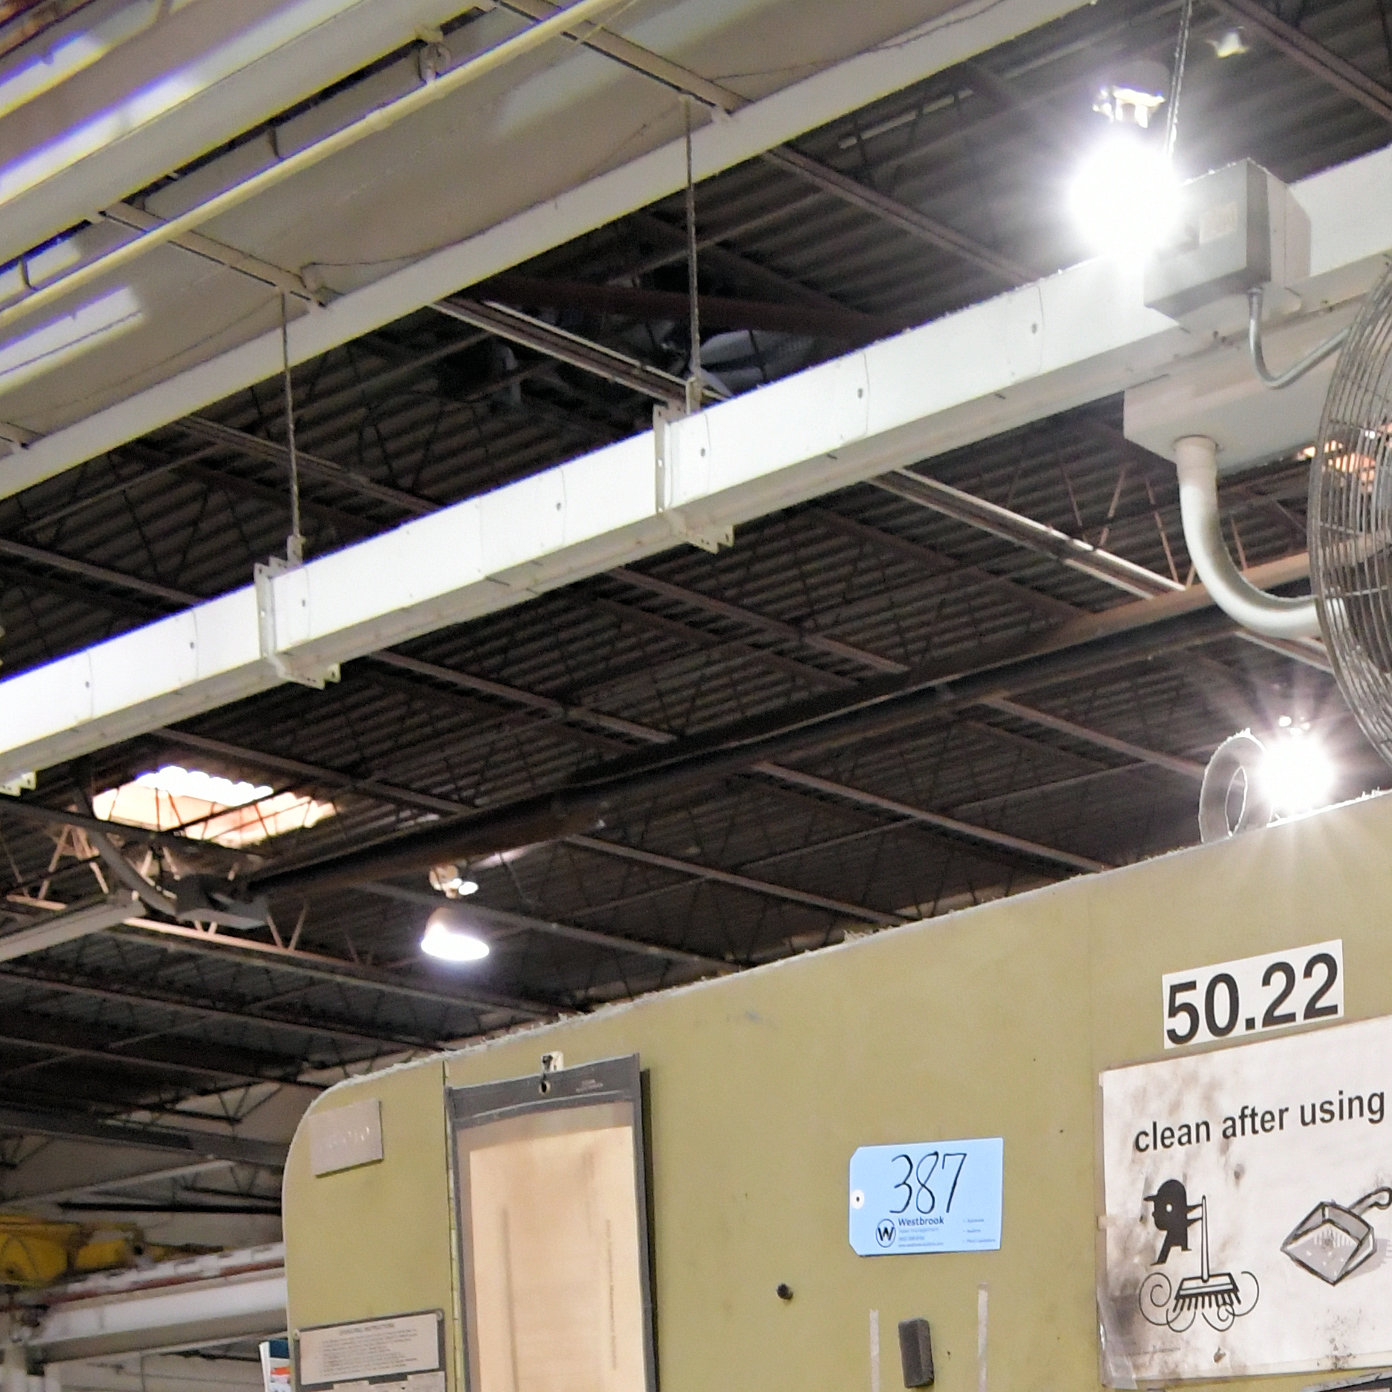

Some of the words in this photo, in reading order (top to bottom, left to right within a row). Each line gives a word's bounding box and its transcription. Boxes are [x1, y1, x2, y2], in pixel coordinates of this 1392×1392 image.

[1166, 953, 1338, 1044] 50.22
[1134, 1119, 1211, 1153] clean
[1222, 1105, 1289, 1140] after
[1299, 1090, 1385, 1124] using
[889, 1151, 967, 1214] 387
[898, 1216, 944, 1226] Westbrook
